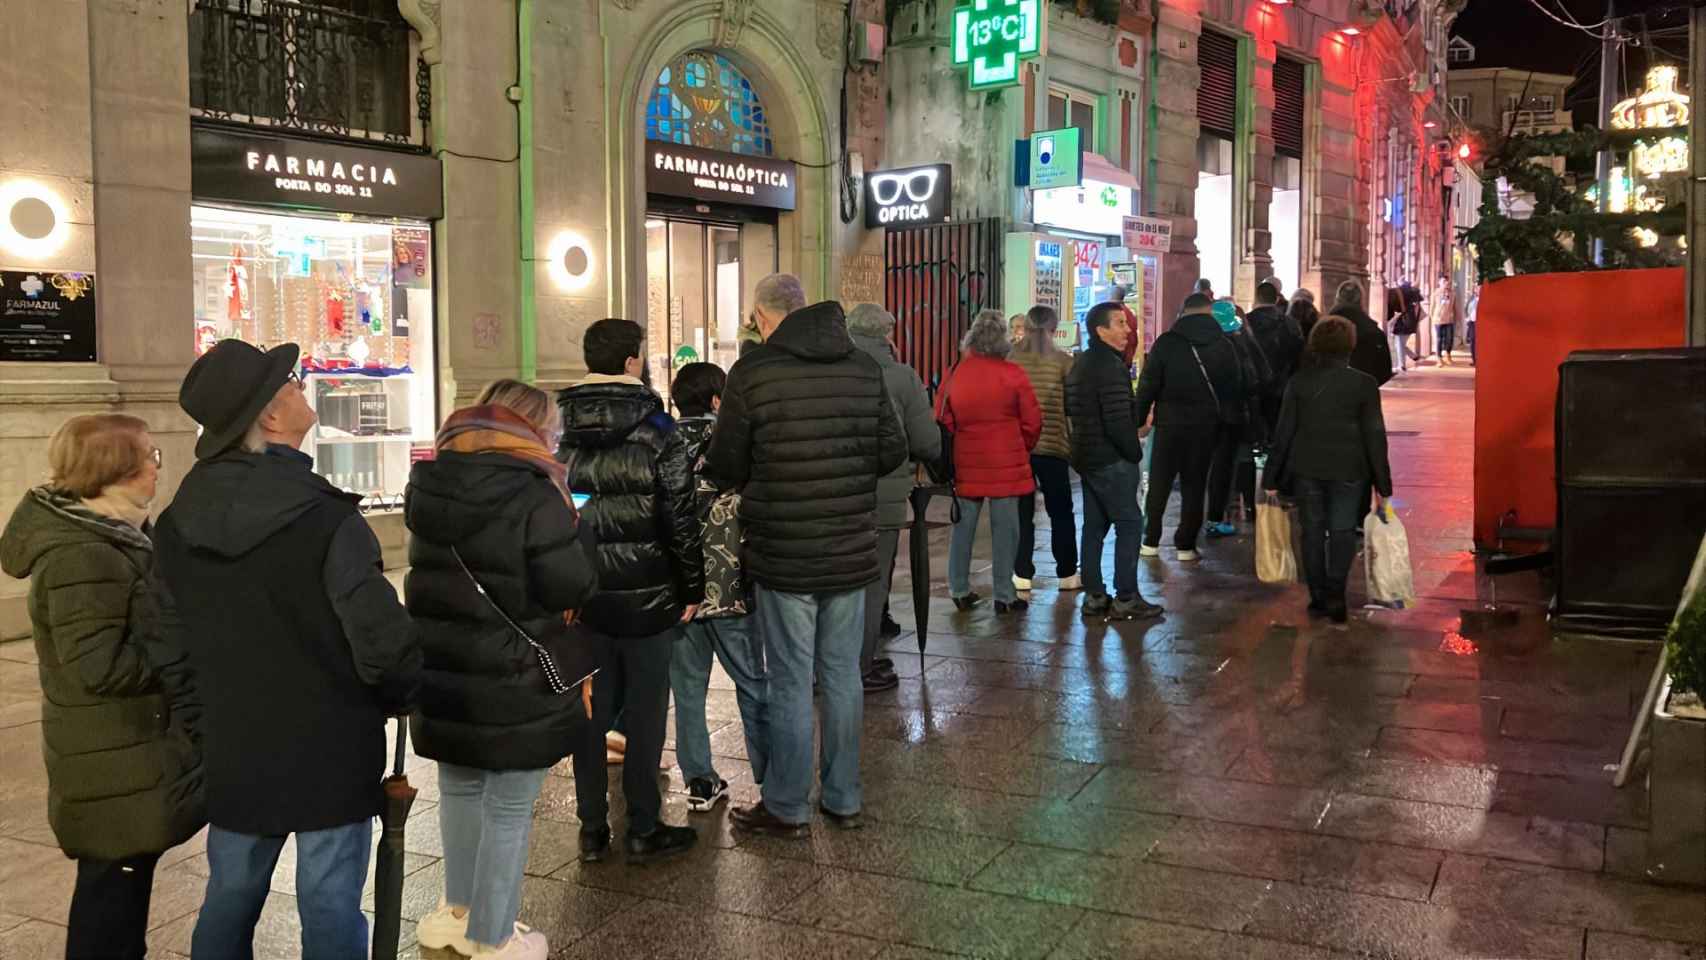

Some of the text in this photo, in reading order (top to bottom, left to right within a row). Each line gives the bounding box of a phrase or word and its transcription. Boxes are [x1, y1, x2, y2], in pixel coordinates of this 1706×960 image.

[246, 151, 397, 186] FARMACIA
[275, 177, 312, 192] PORTA
[314, 182, 332, 194] DO
[334, 184, 356, 196] SOL
